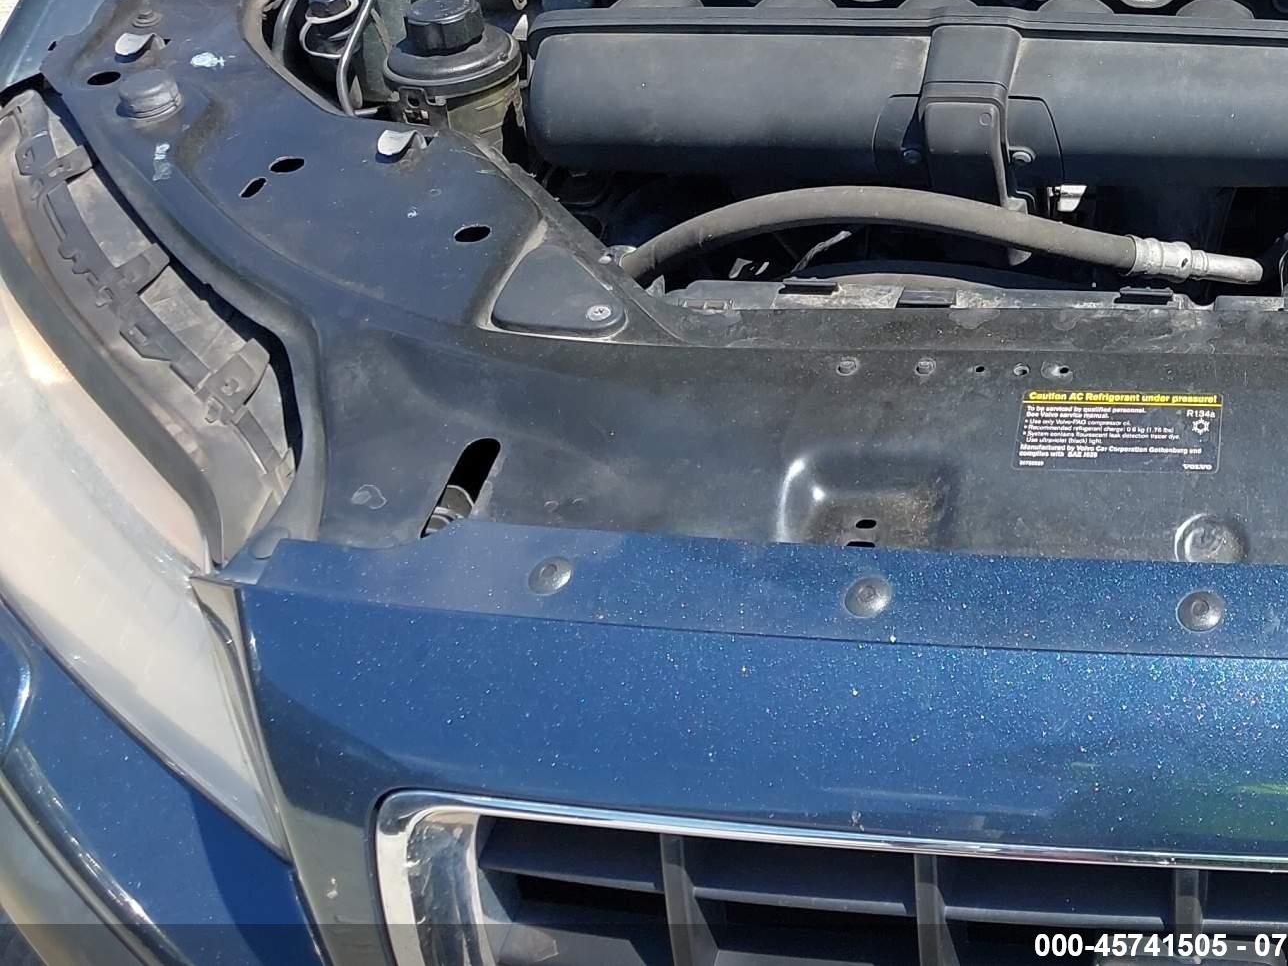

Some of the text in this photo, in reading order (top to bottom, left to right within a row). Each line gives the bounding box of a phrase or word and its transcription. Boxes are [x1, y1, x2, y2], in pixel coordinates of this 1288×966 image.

[1028, 391, 1218, 404] Caution AC Refrigerant under pressure!
[1186, 409, 1216, 418] R134a
[1019, 443, 1066, 451] Manufactured
[1108, 445, 1148, 453] Corporation
[1148, 446, 1188, 454] Gothenburg
[1018, 450, 1049, 458] complies
